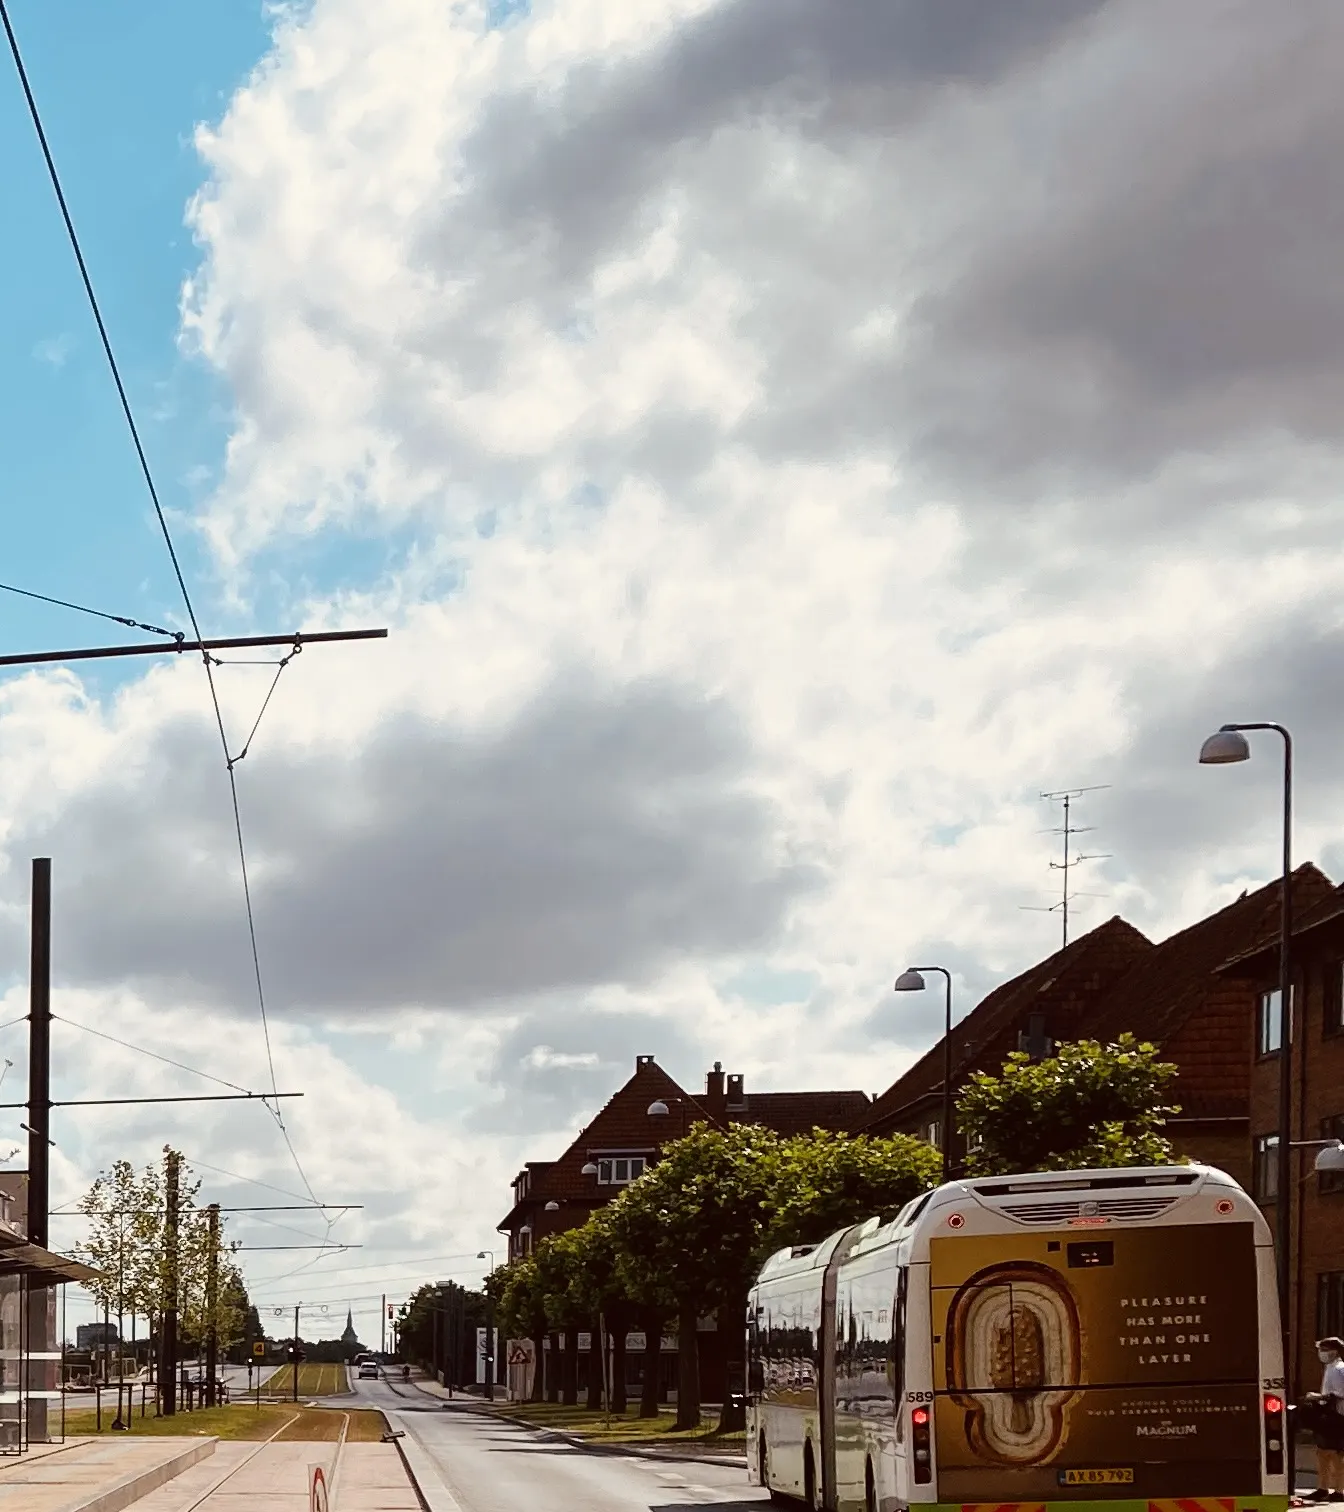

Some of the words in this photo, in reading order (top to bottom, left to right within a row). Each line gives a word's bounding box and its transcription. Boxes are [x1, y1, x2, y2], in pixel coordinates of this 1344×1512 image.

[1120, 1295, 1207, 1307] PLEASURE
[1126, 1317, 1155, 1326] HAS
[1161, 1315, 1201, 1325] MORE
[1119, 1335, 1166, 1346] THAN
[1175, 1333, 1210, 1344] ONE
[1138, 1354, 1191, 1365] LAYER
[1136, 1424, 1198, 1436] MAGNUM
[1068, 1471, 1085, 1482] AX
[1107, 1469, 1132, 1481] 792
